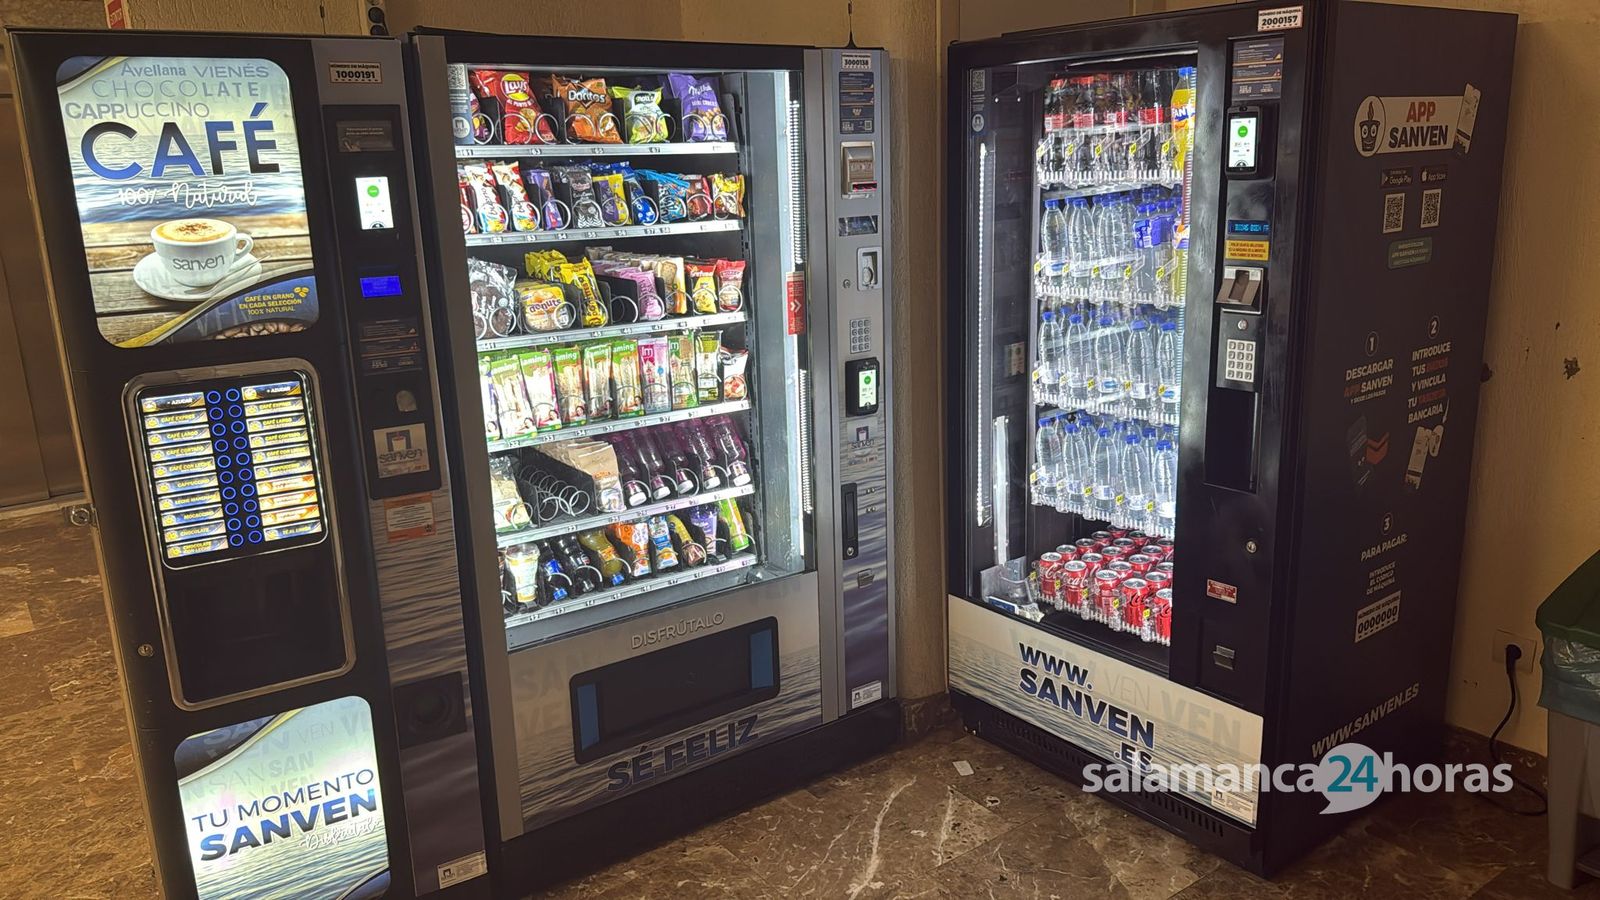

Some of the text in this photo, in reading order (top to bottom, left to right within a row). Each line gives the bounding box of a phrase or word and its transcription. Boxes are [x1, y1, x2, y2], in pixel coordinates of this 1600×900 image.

[1262, 15, 1298, 26] 2000157
[121, 62, 270, 78] Avellana VIENÉS
[336, 70, 376, 78] 1000191
[91, 79, 260, 98] CHOCOLATE
[568, 90, 606, 103] Doritos
[65, 101, 210, 120] CAPPUCCINO
[1406, 101, 1436, 123] APP
[80, 102, 281, 181] CAFÉ
[1389, 125, 1449, 149] SANVEN
[1390, 176, 1404, 186] Google
[163, 181, 260, 209] Natural
[172, 254, 225, 271] sanven
[239, 302, 249, 310] EN
[249, 301, 267, 309] CADA
[244, 294, 262, 302] CAFÉ
[272, 292, 295, 301] GRANO
[530, 298, 562, 313] donuts
[1412, 342, 1451, 361] INTRODUCE
[1346, 358, 1394, 381] DESCARGAR
[1412, 364, 1426, 376] TUS
[1360, 374, 1394, 392] SANVEN
[1412, 374, 1446, 392] Y VINCULA
[1408, 397, 1417, 408] TU
[1408, 403, 1444, 424] BANCARIA
[1361, 544, 1381, 562] PARA
[1358, 606, 1398, 633] 0000000
[630, 611, 725, 650] DISFRÚTALO
[1018, 641, 1093, 690] WWW.
[1018, 667, 1155, 750] SANVEN
[1310, 682, 1420, 758] WWW.SANVEN.ES
[606, 714, 760, 792] SÉ FELIZ
[192, 768, 374, 832] TU MOMENTO
[200, 789, 377, 862] SANVEN
